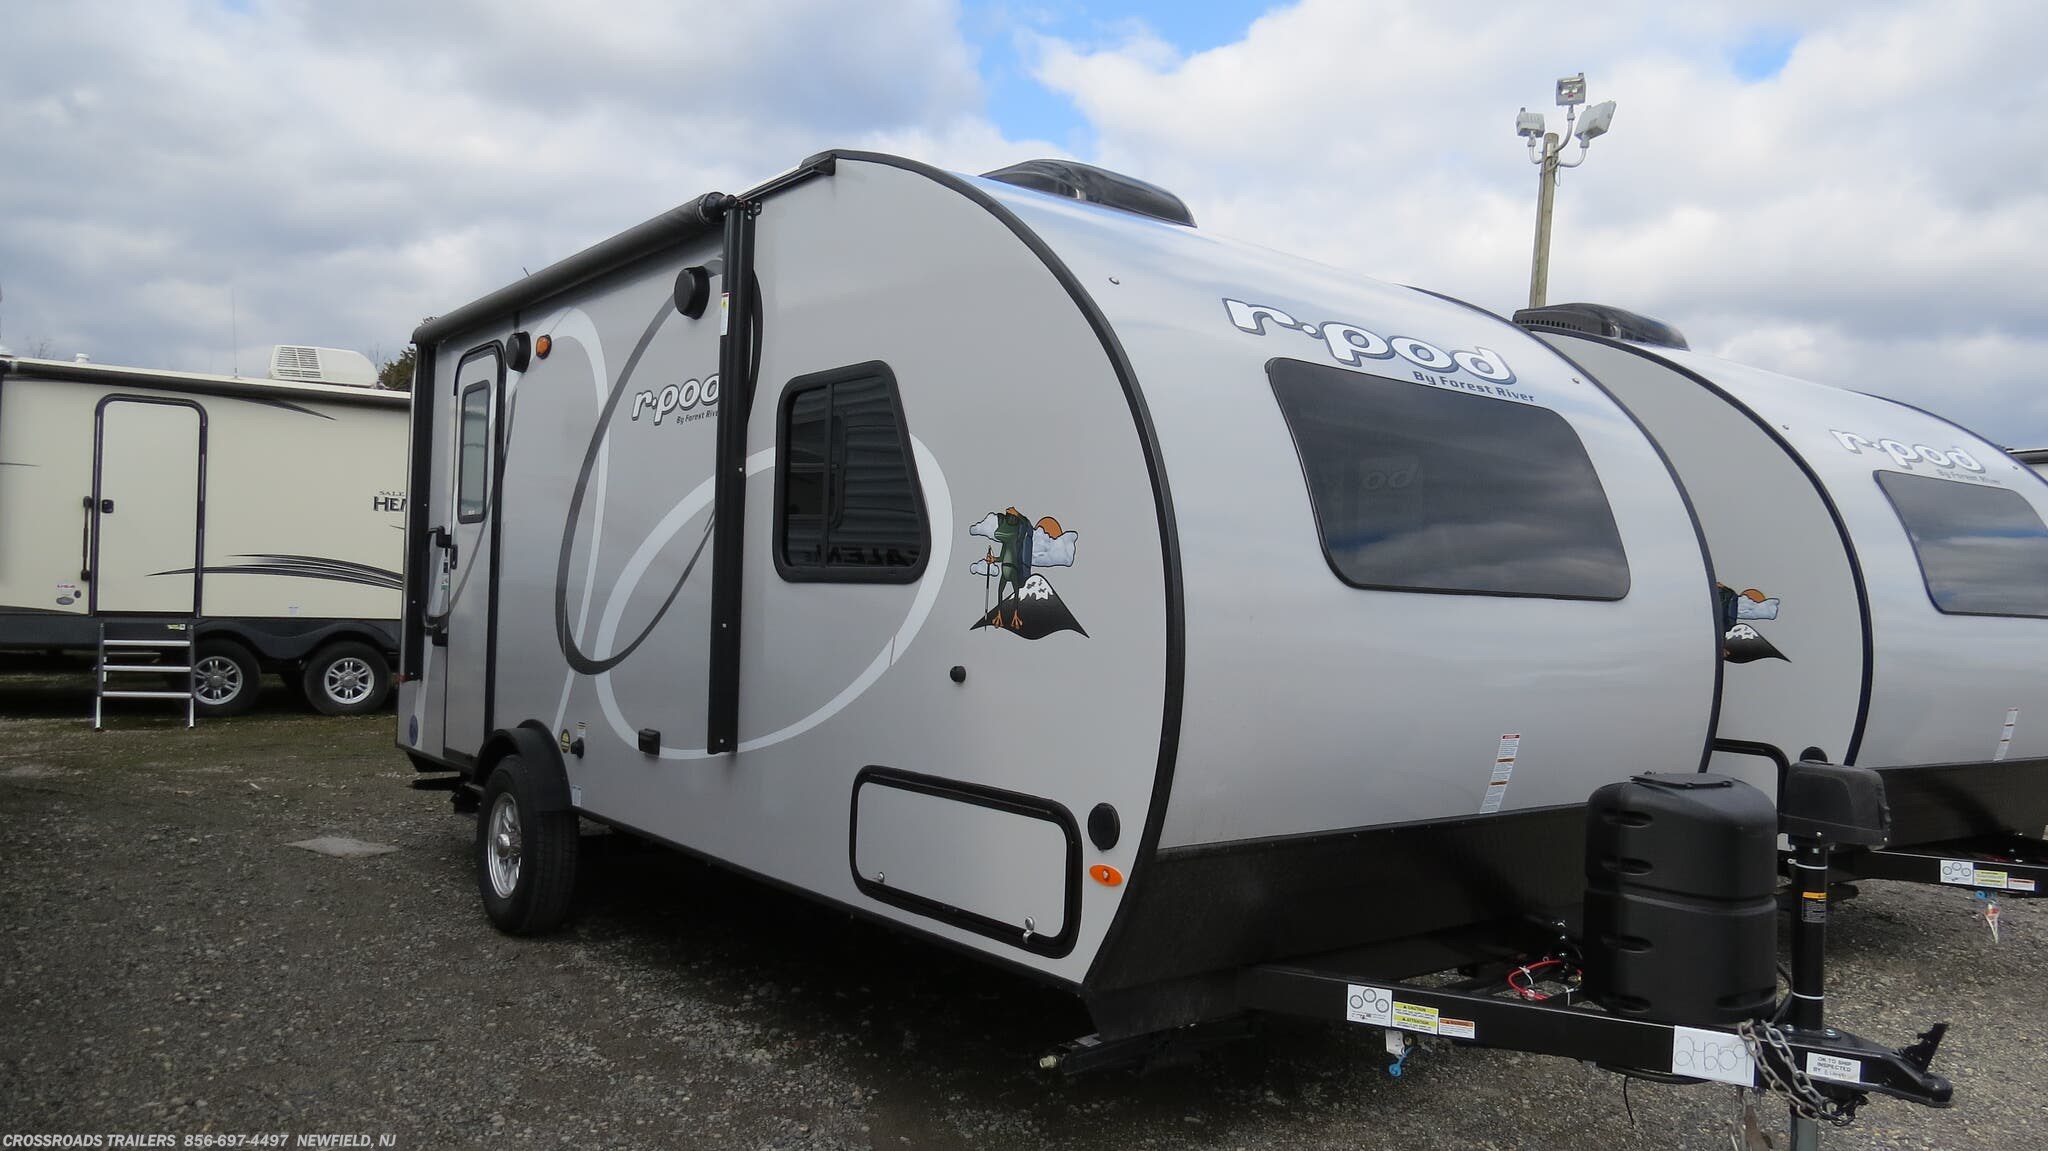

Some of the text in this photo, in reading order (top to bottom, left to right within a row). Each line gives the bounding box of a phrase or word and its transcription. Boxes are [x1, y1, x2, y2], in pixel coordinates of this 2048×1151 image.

[1412, 371, 1534, 402] By Forest River
[685, 411, 704, 422] Forest
